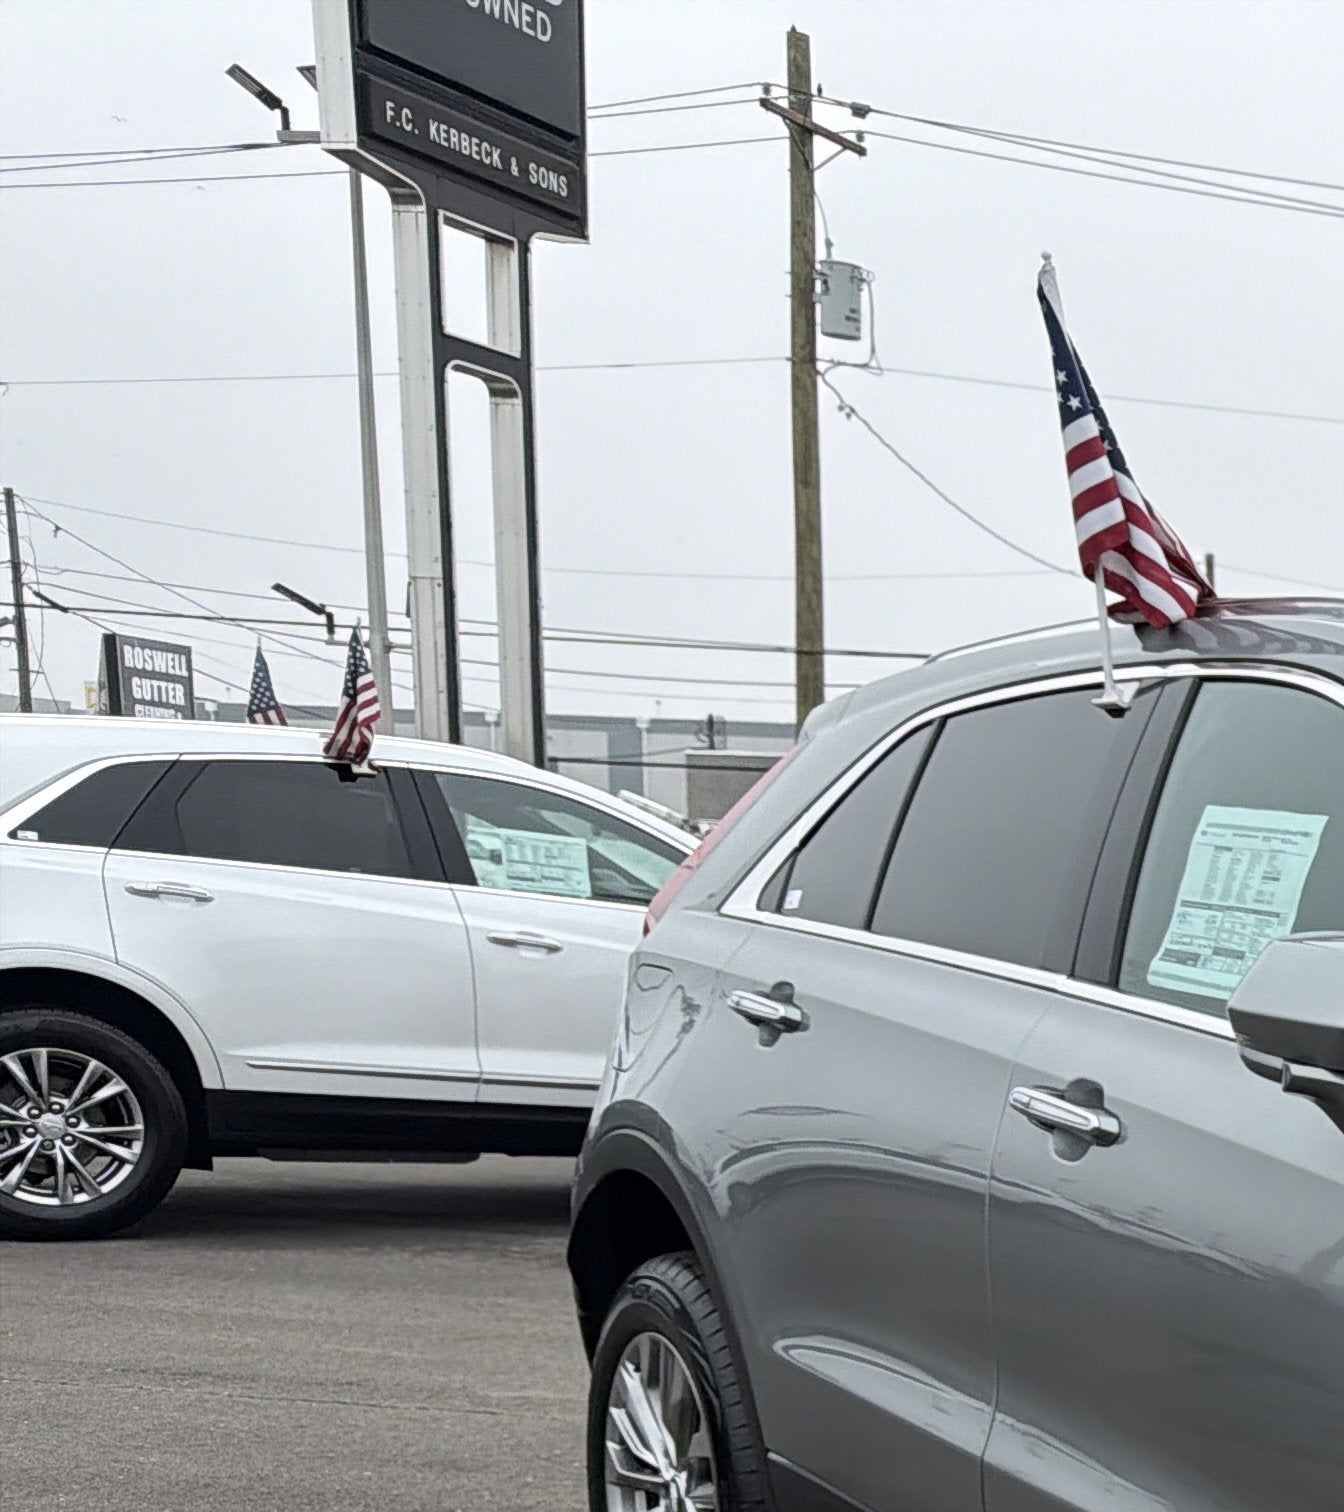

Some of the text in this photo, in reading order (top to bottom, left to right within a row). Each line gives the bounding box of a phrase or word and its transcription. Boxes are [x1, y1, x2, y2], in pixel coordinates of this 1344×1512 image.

[466, 0, 552, 42] WNED
[385, 101, 568, 197] F.C. KERBECK & SONS
[132, 677, 185, 705] GUTTER
